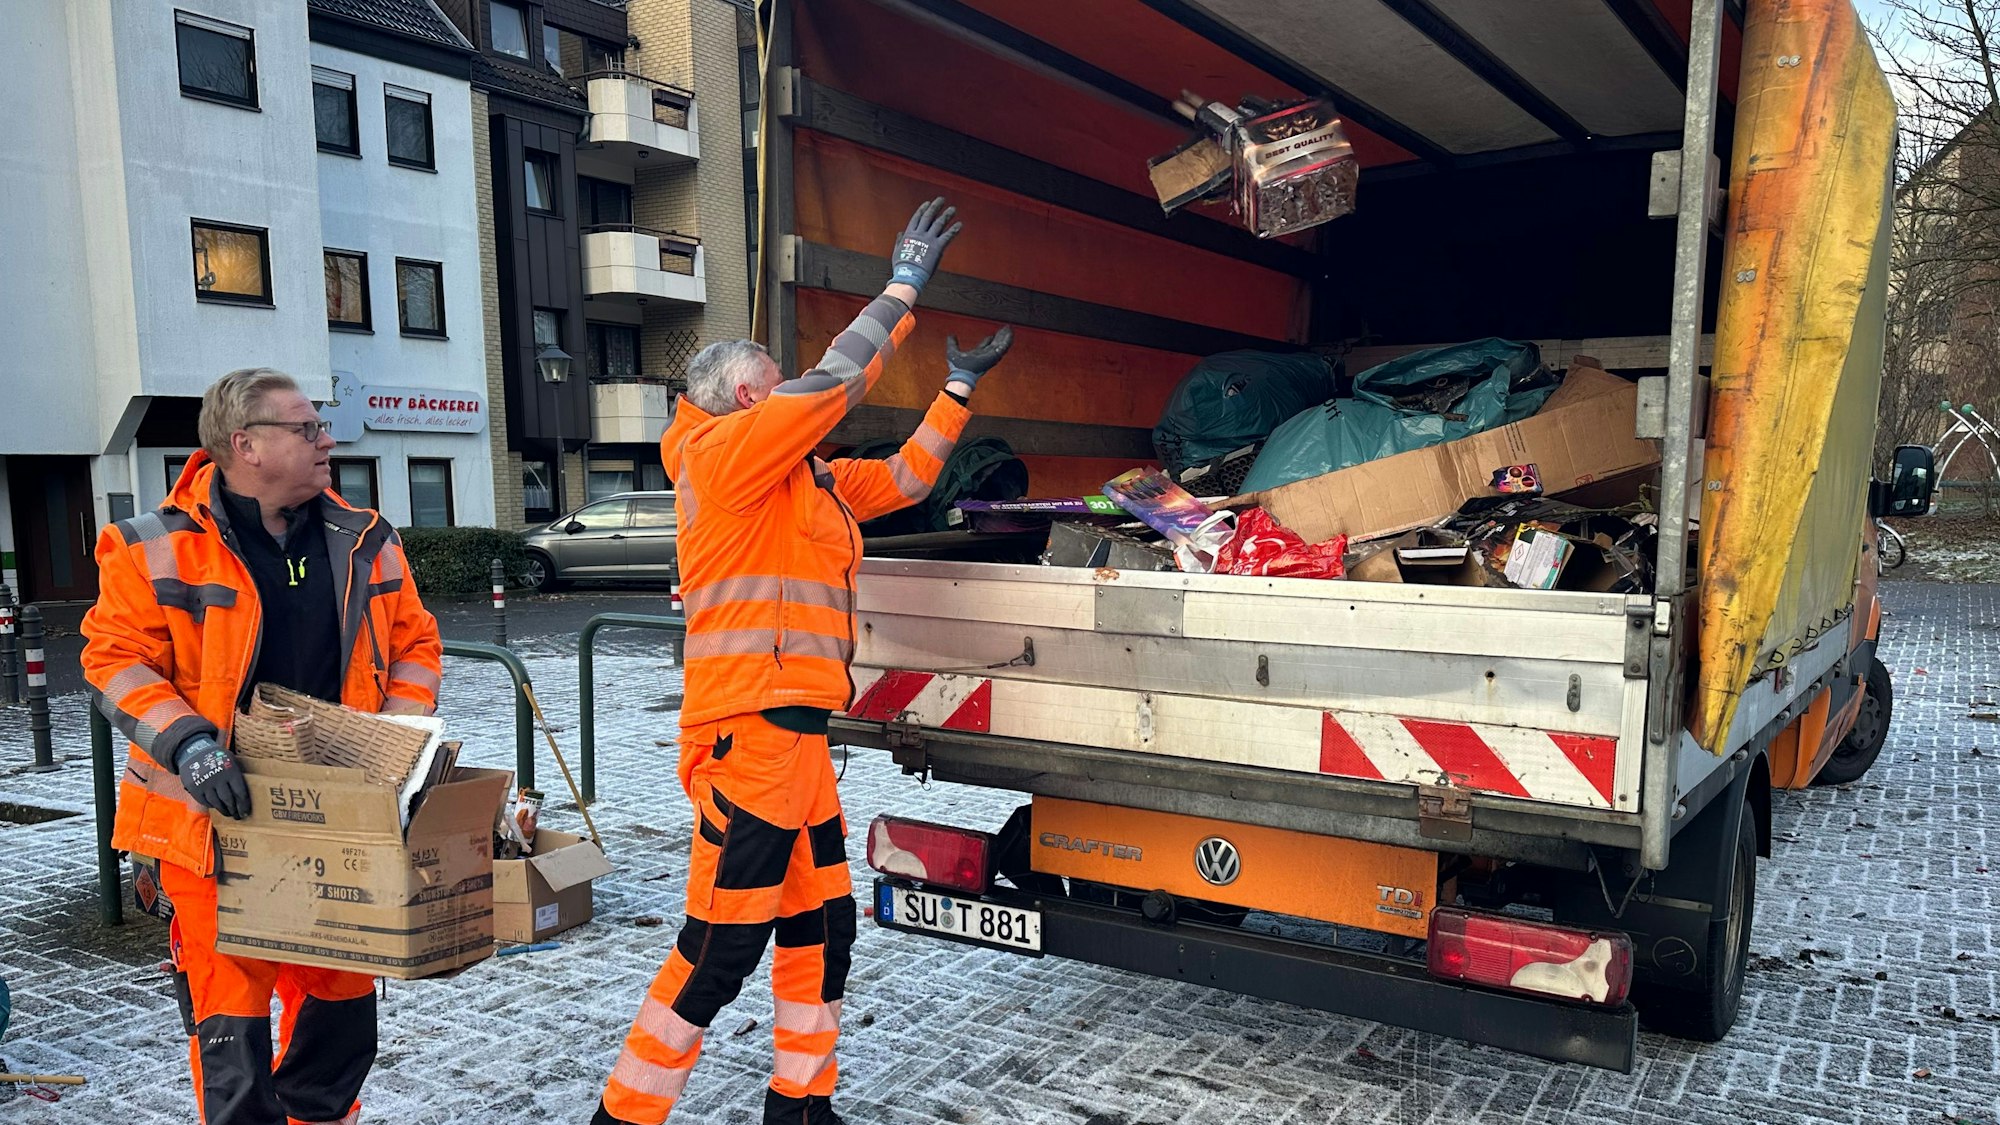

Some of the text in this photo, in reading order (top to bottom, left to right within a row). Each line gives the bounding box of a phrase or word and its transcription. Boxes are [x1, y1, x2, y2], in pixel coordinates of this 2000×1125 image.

[1265, 132, 1334, 159] BEST QUALITY
[368, 394, 479, 413] CITY BÄCKEREI
[374, 414, 394, 424] alles
[425, 414, 443, 426] alles
[1089, 501, 1109, 510] 30
[288, 811, 324, 823] FIREWORKS
[1040, 832, 1142, 861] CRAFTER
[327, 886, 360, 901] SHOTS
[1377, 885, 1423, 906] TDI
[905, 893, 1030, 944] SU T 881
